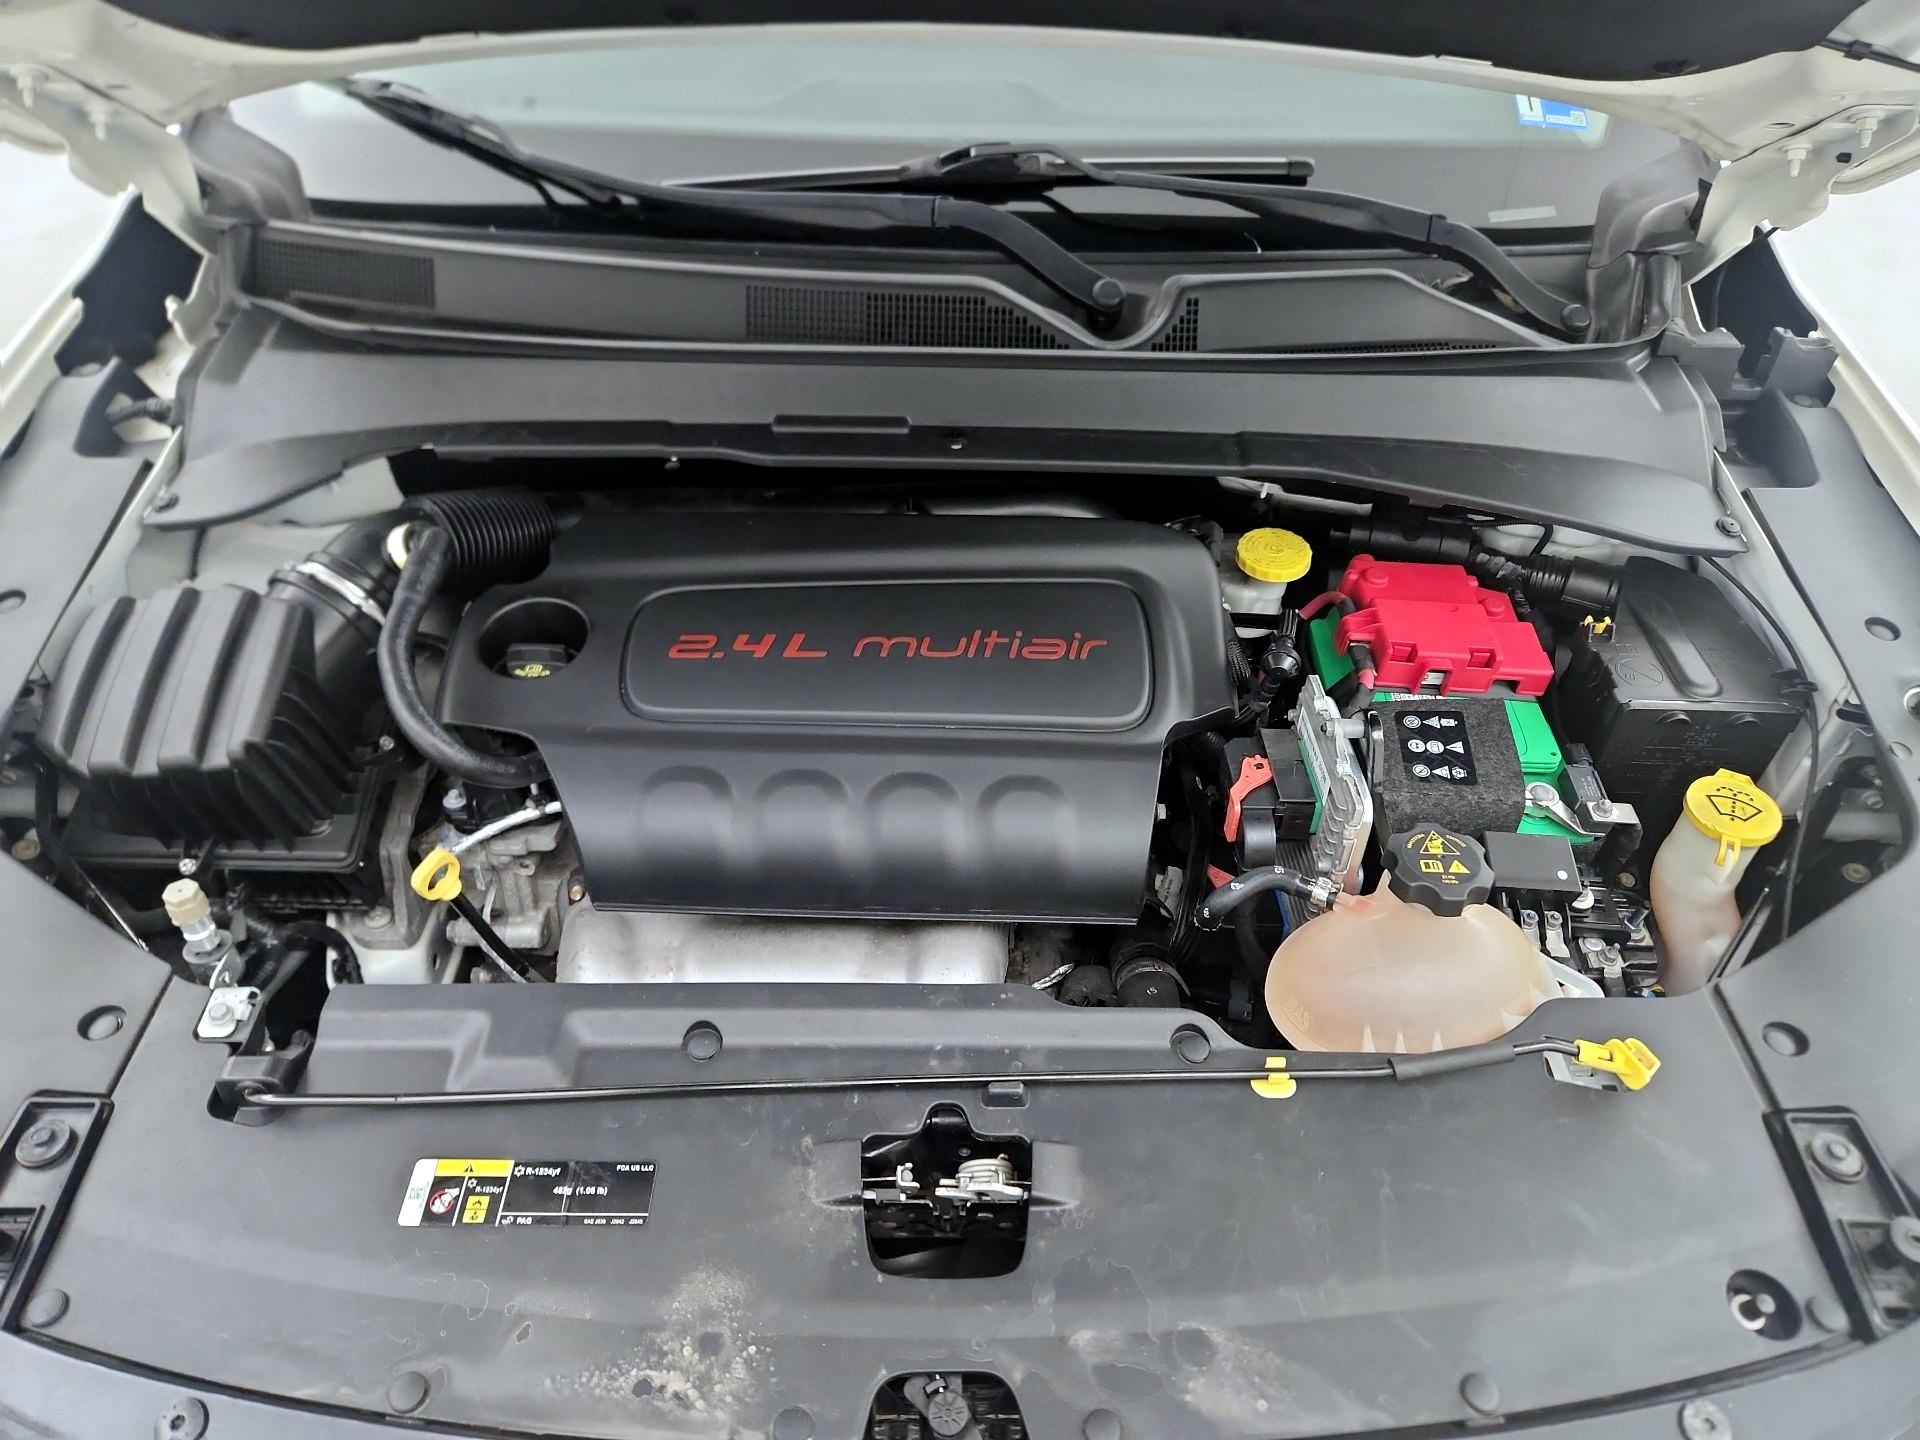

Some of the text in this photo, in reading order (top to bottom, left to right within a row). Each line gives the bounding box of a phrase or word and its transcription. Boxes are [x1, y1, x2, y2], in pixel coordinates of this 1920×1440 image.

[668, 629, 1108, 660] 2.4L multiair
[525, 1166, 561, 1177] R-1234yf
